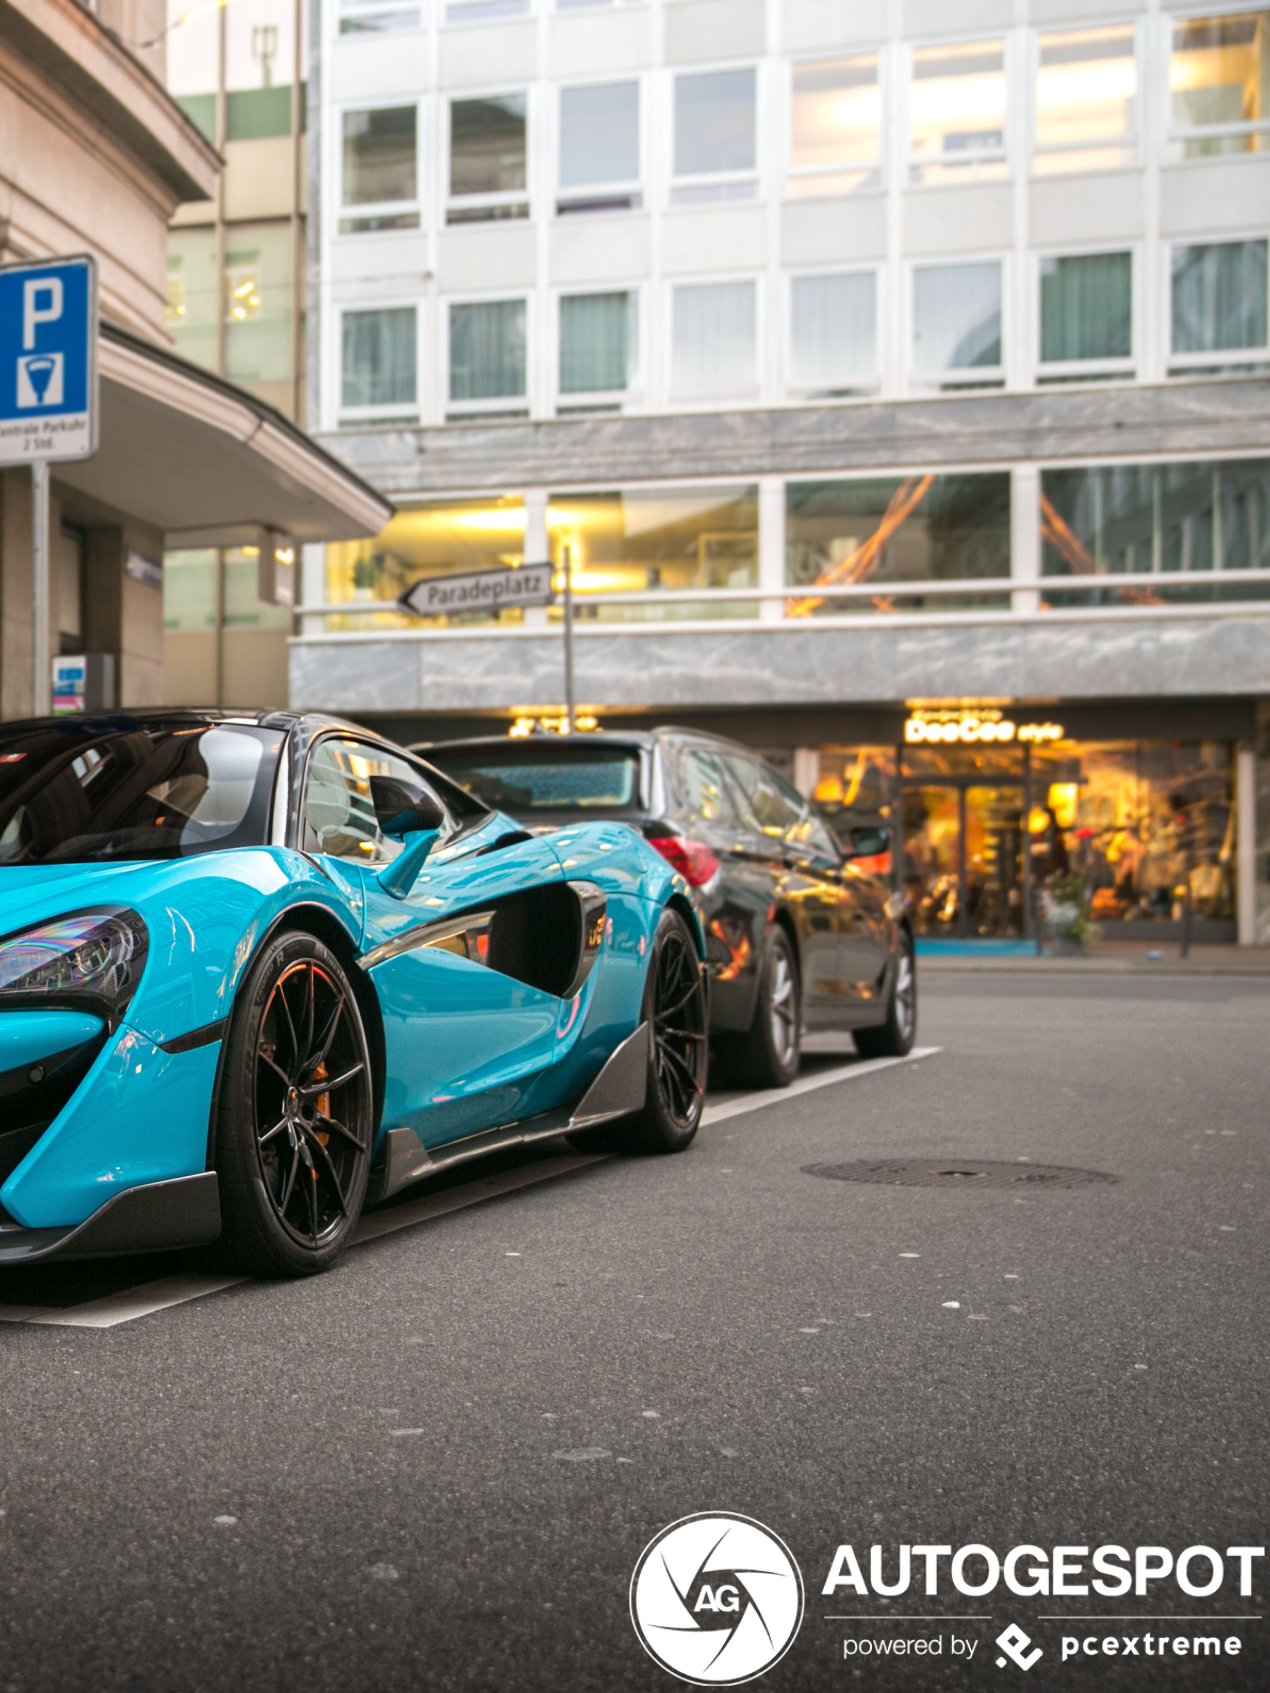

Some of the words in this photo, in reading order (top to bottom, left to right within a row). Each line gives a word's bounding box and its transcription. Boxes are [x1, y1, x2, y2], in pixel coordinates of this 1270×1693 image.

[23, 277, 63, 350] P
[43, 418, 86, 434] Parkuhr
[23, 438, 31, 451] 2
[427, 575, 542, 606] Paradeplatz
